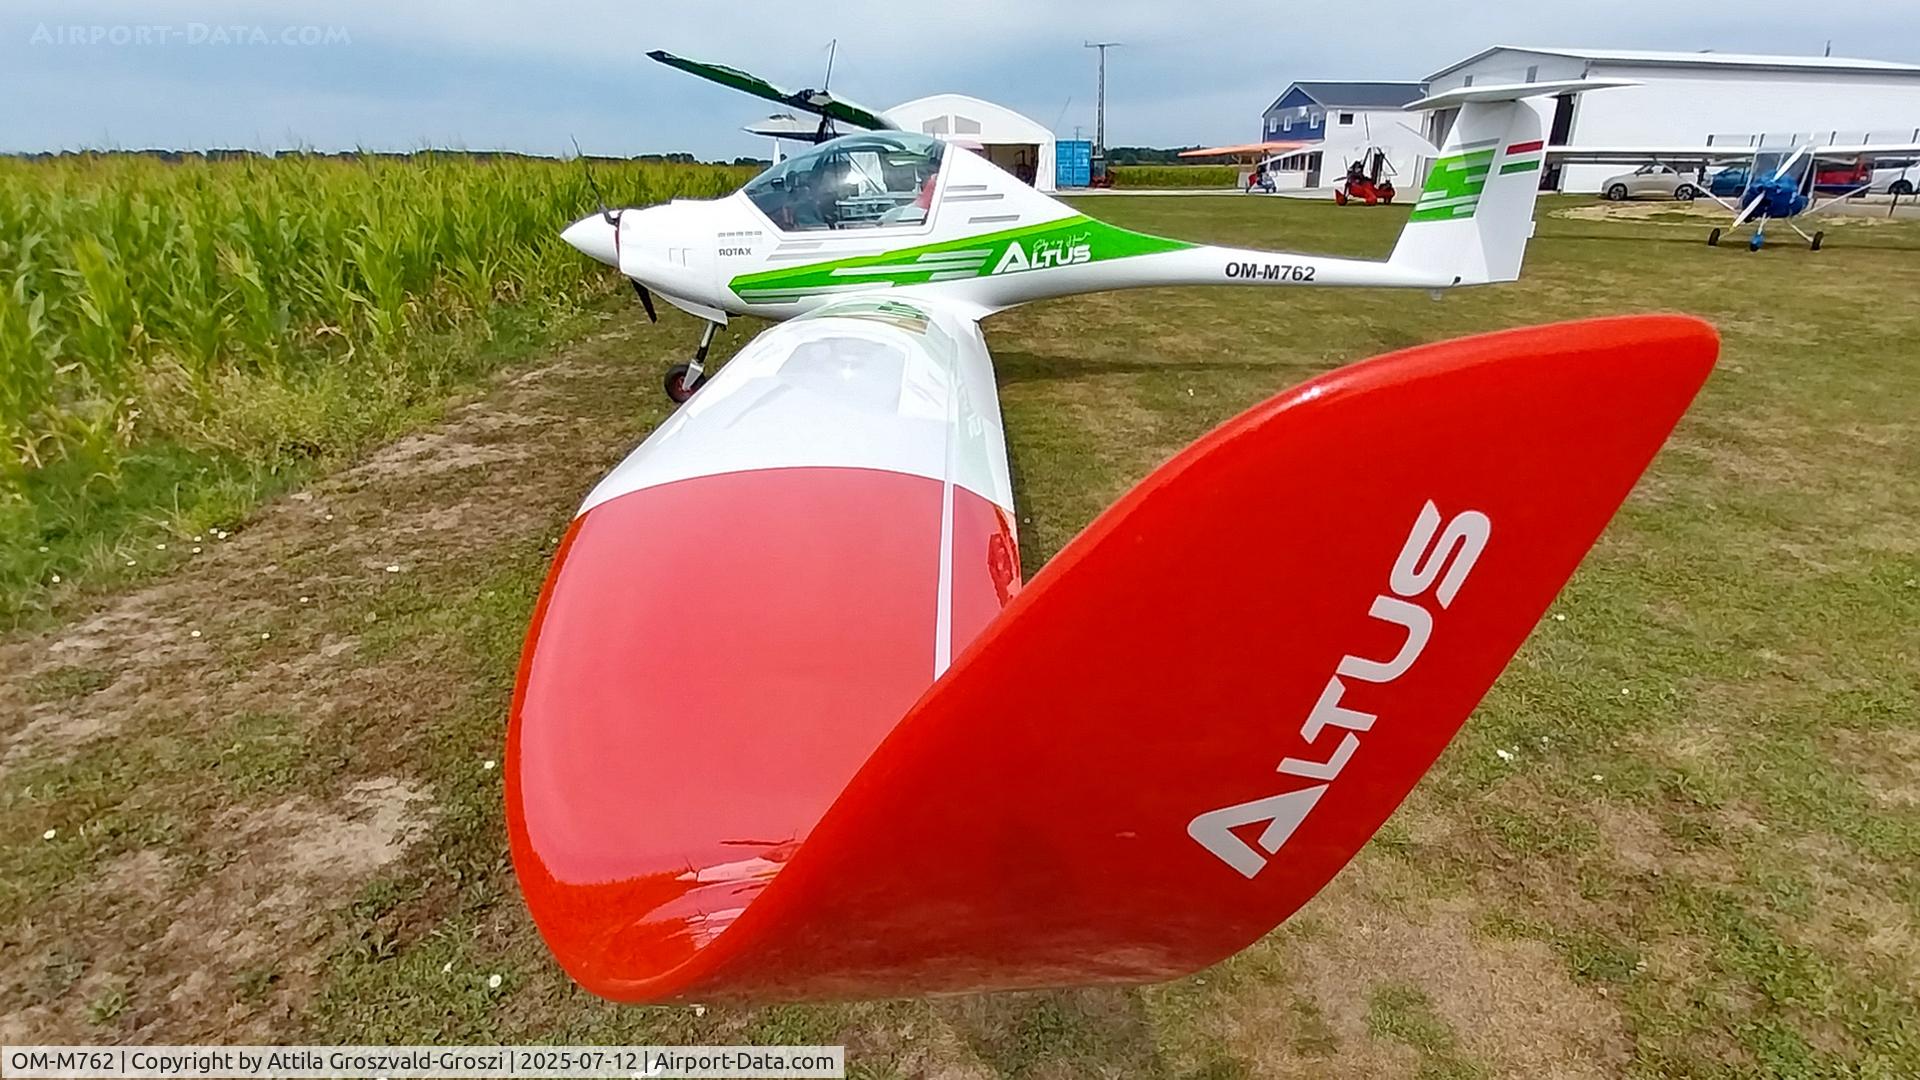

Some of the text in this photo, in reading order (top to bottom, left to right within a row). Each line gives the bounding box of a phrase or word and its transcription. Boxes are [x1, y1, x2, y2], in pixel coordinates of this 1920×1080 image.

[991, 241, 1091, 274] ALTUS
[1225, 262, 1315, 281] OM-M762
[1187, 499, 1491, 879] ALTUS
